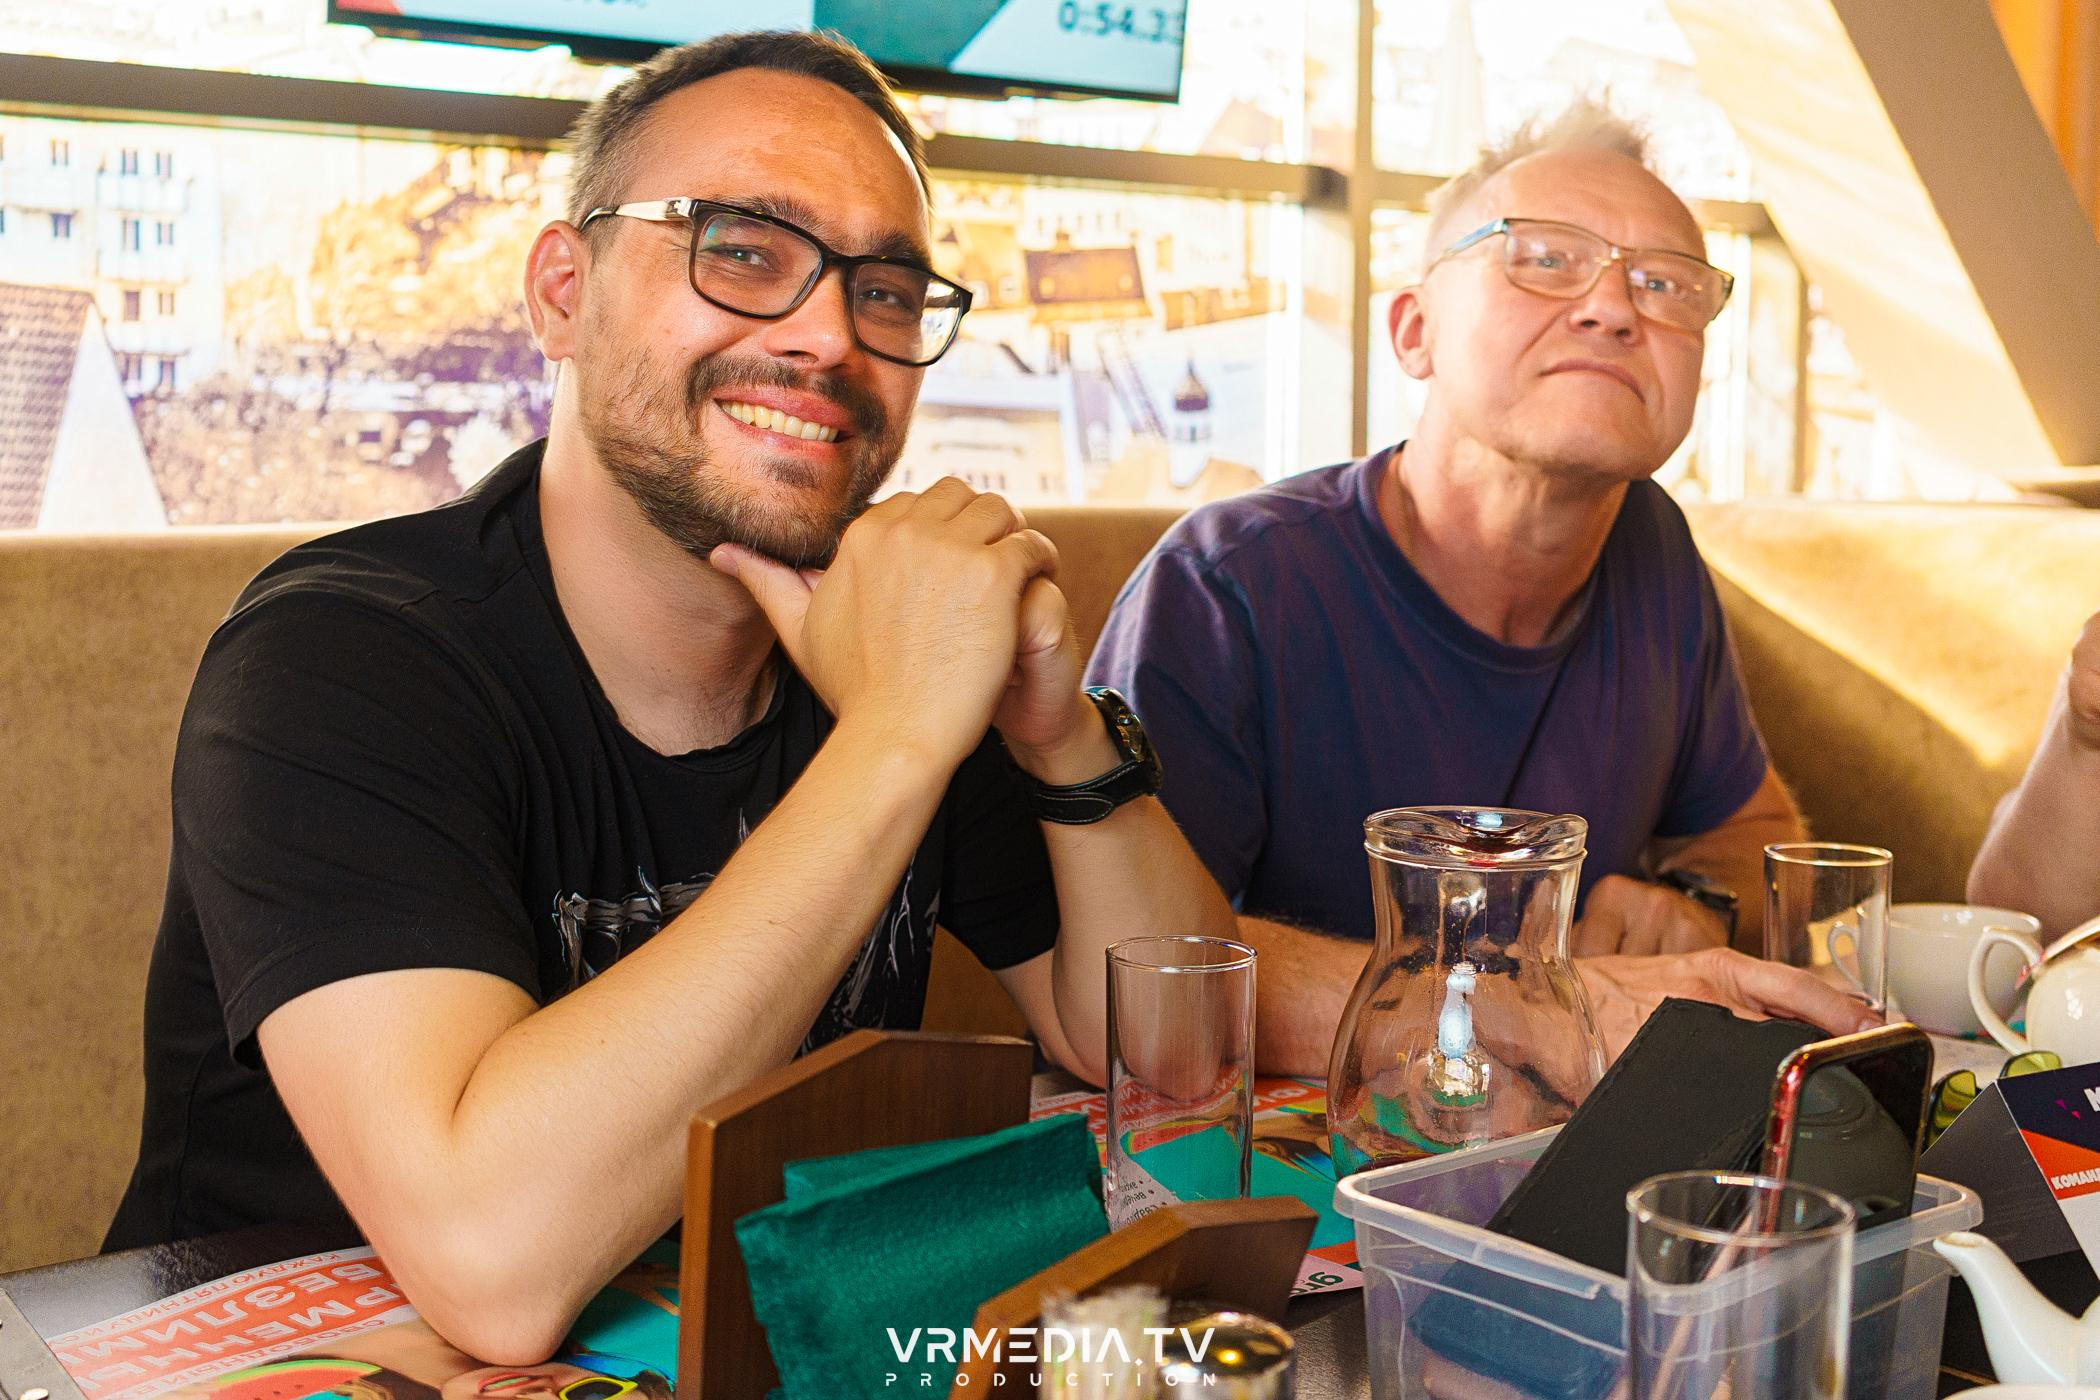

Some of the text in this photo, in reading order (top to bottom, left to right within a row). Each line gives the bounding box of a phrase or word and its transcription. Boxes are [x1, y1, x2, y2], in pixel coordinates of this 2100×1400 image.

[231, 1253, 342, 1285] КАЖДУЮ
[110, 1280, 229, 1330] ПЯТНИЦУ
[73, 1282, 402, 1394] РМЕННЫ
[160, 1319, 386, 1386] СВОБОДНЫЙ
